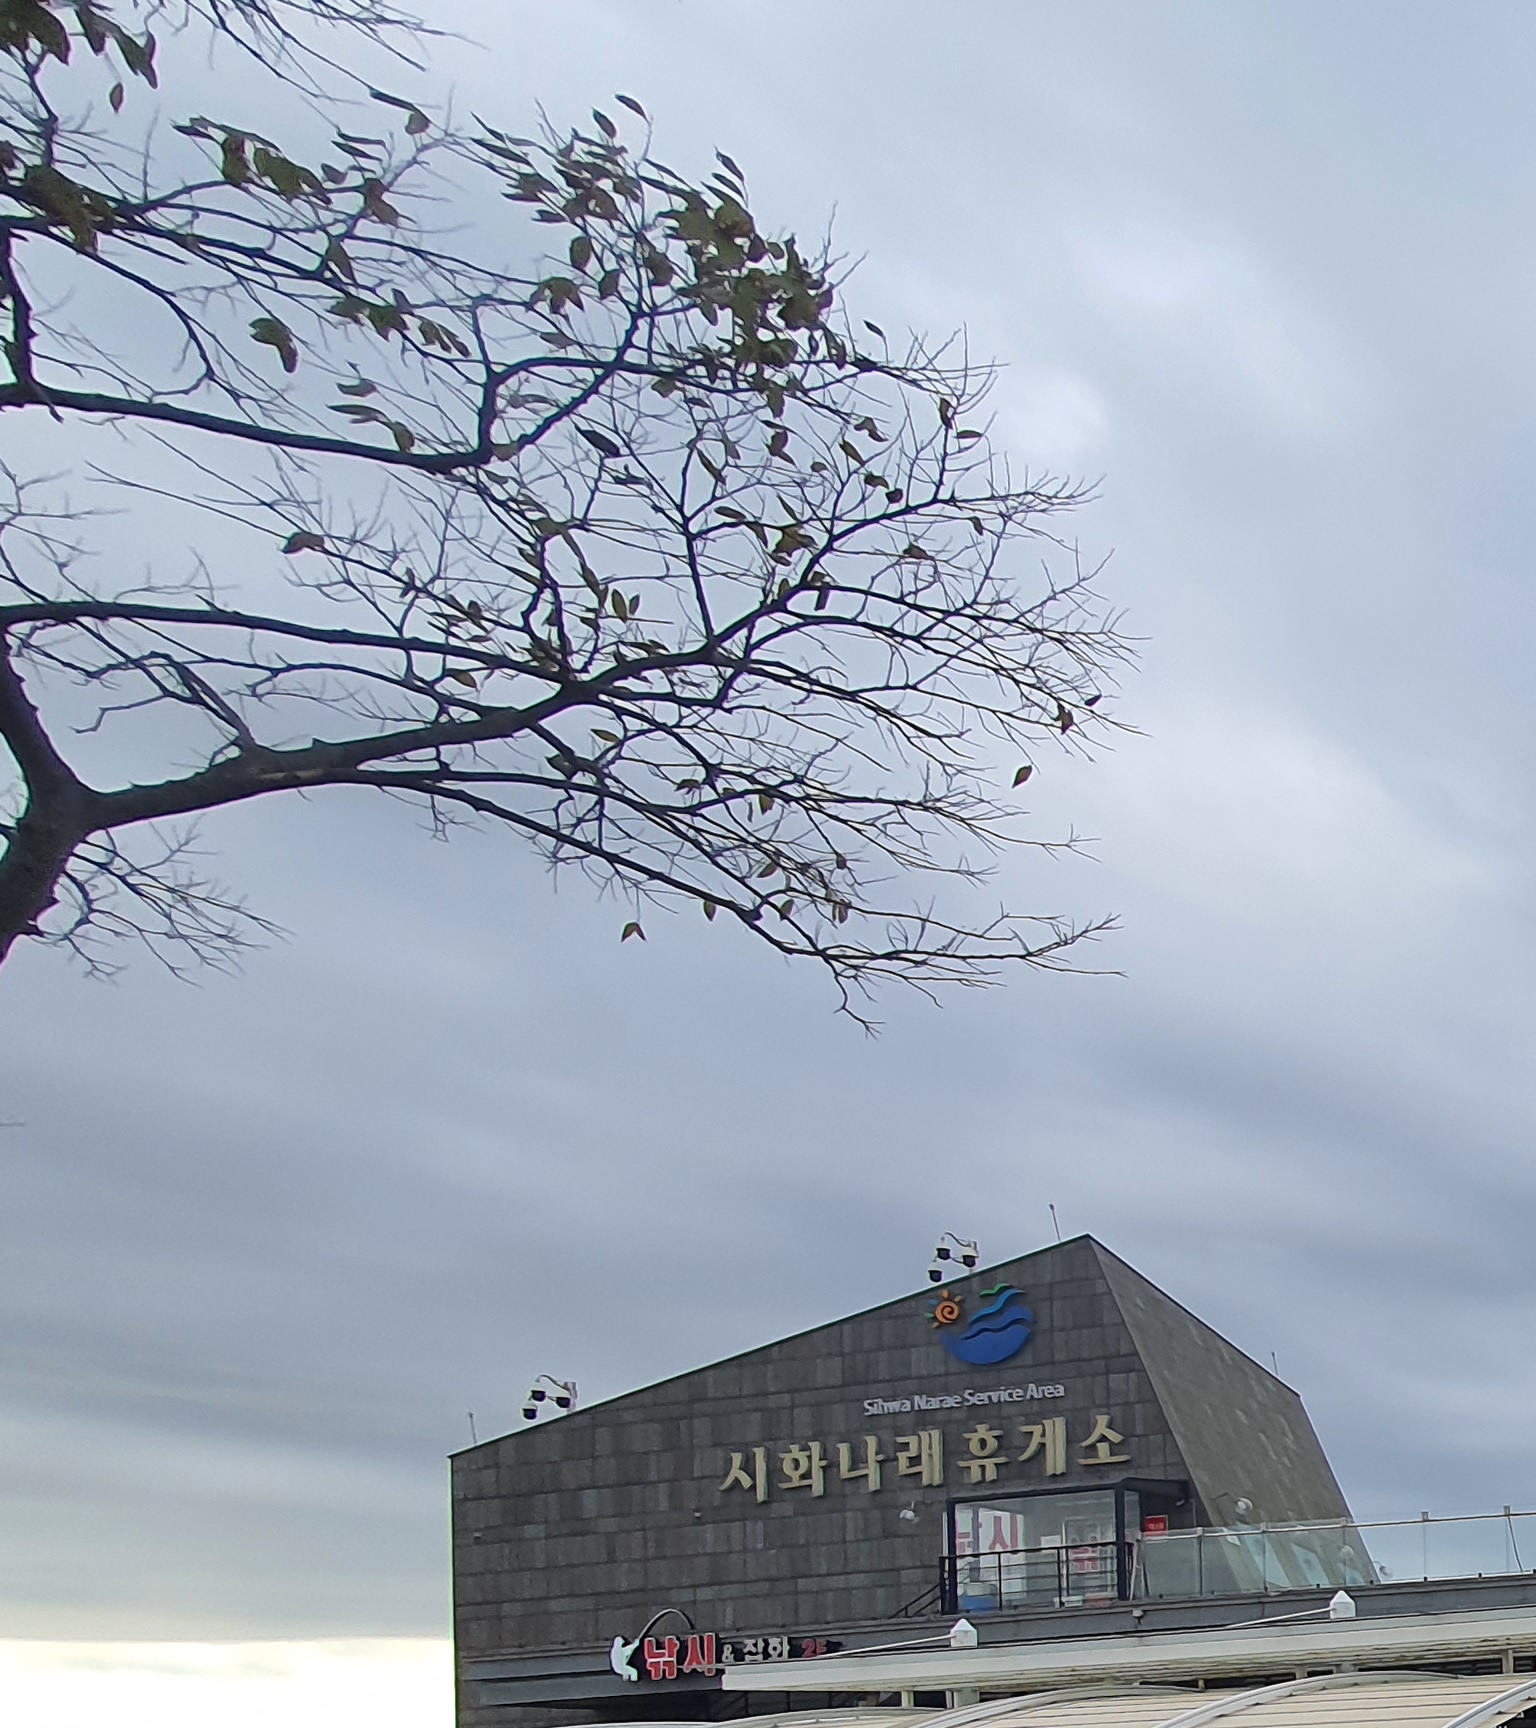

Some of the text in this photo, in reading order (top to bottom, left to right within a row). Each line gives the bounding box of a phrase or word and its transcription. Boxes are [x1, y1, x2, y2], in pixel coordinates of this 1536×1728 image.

[863, 1383, 1065, 1416] Sihwa Narae Service Area
[644, 1632, 717, 1681] 낚시
